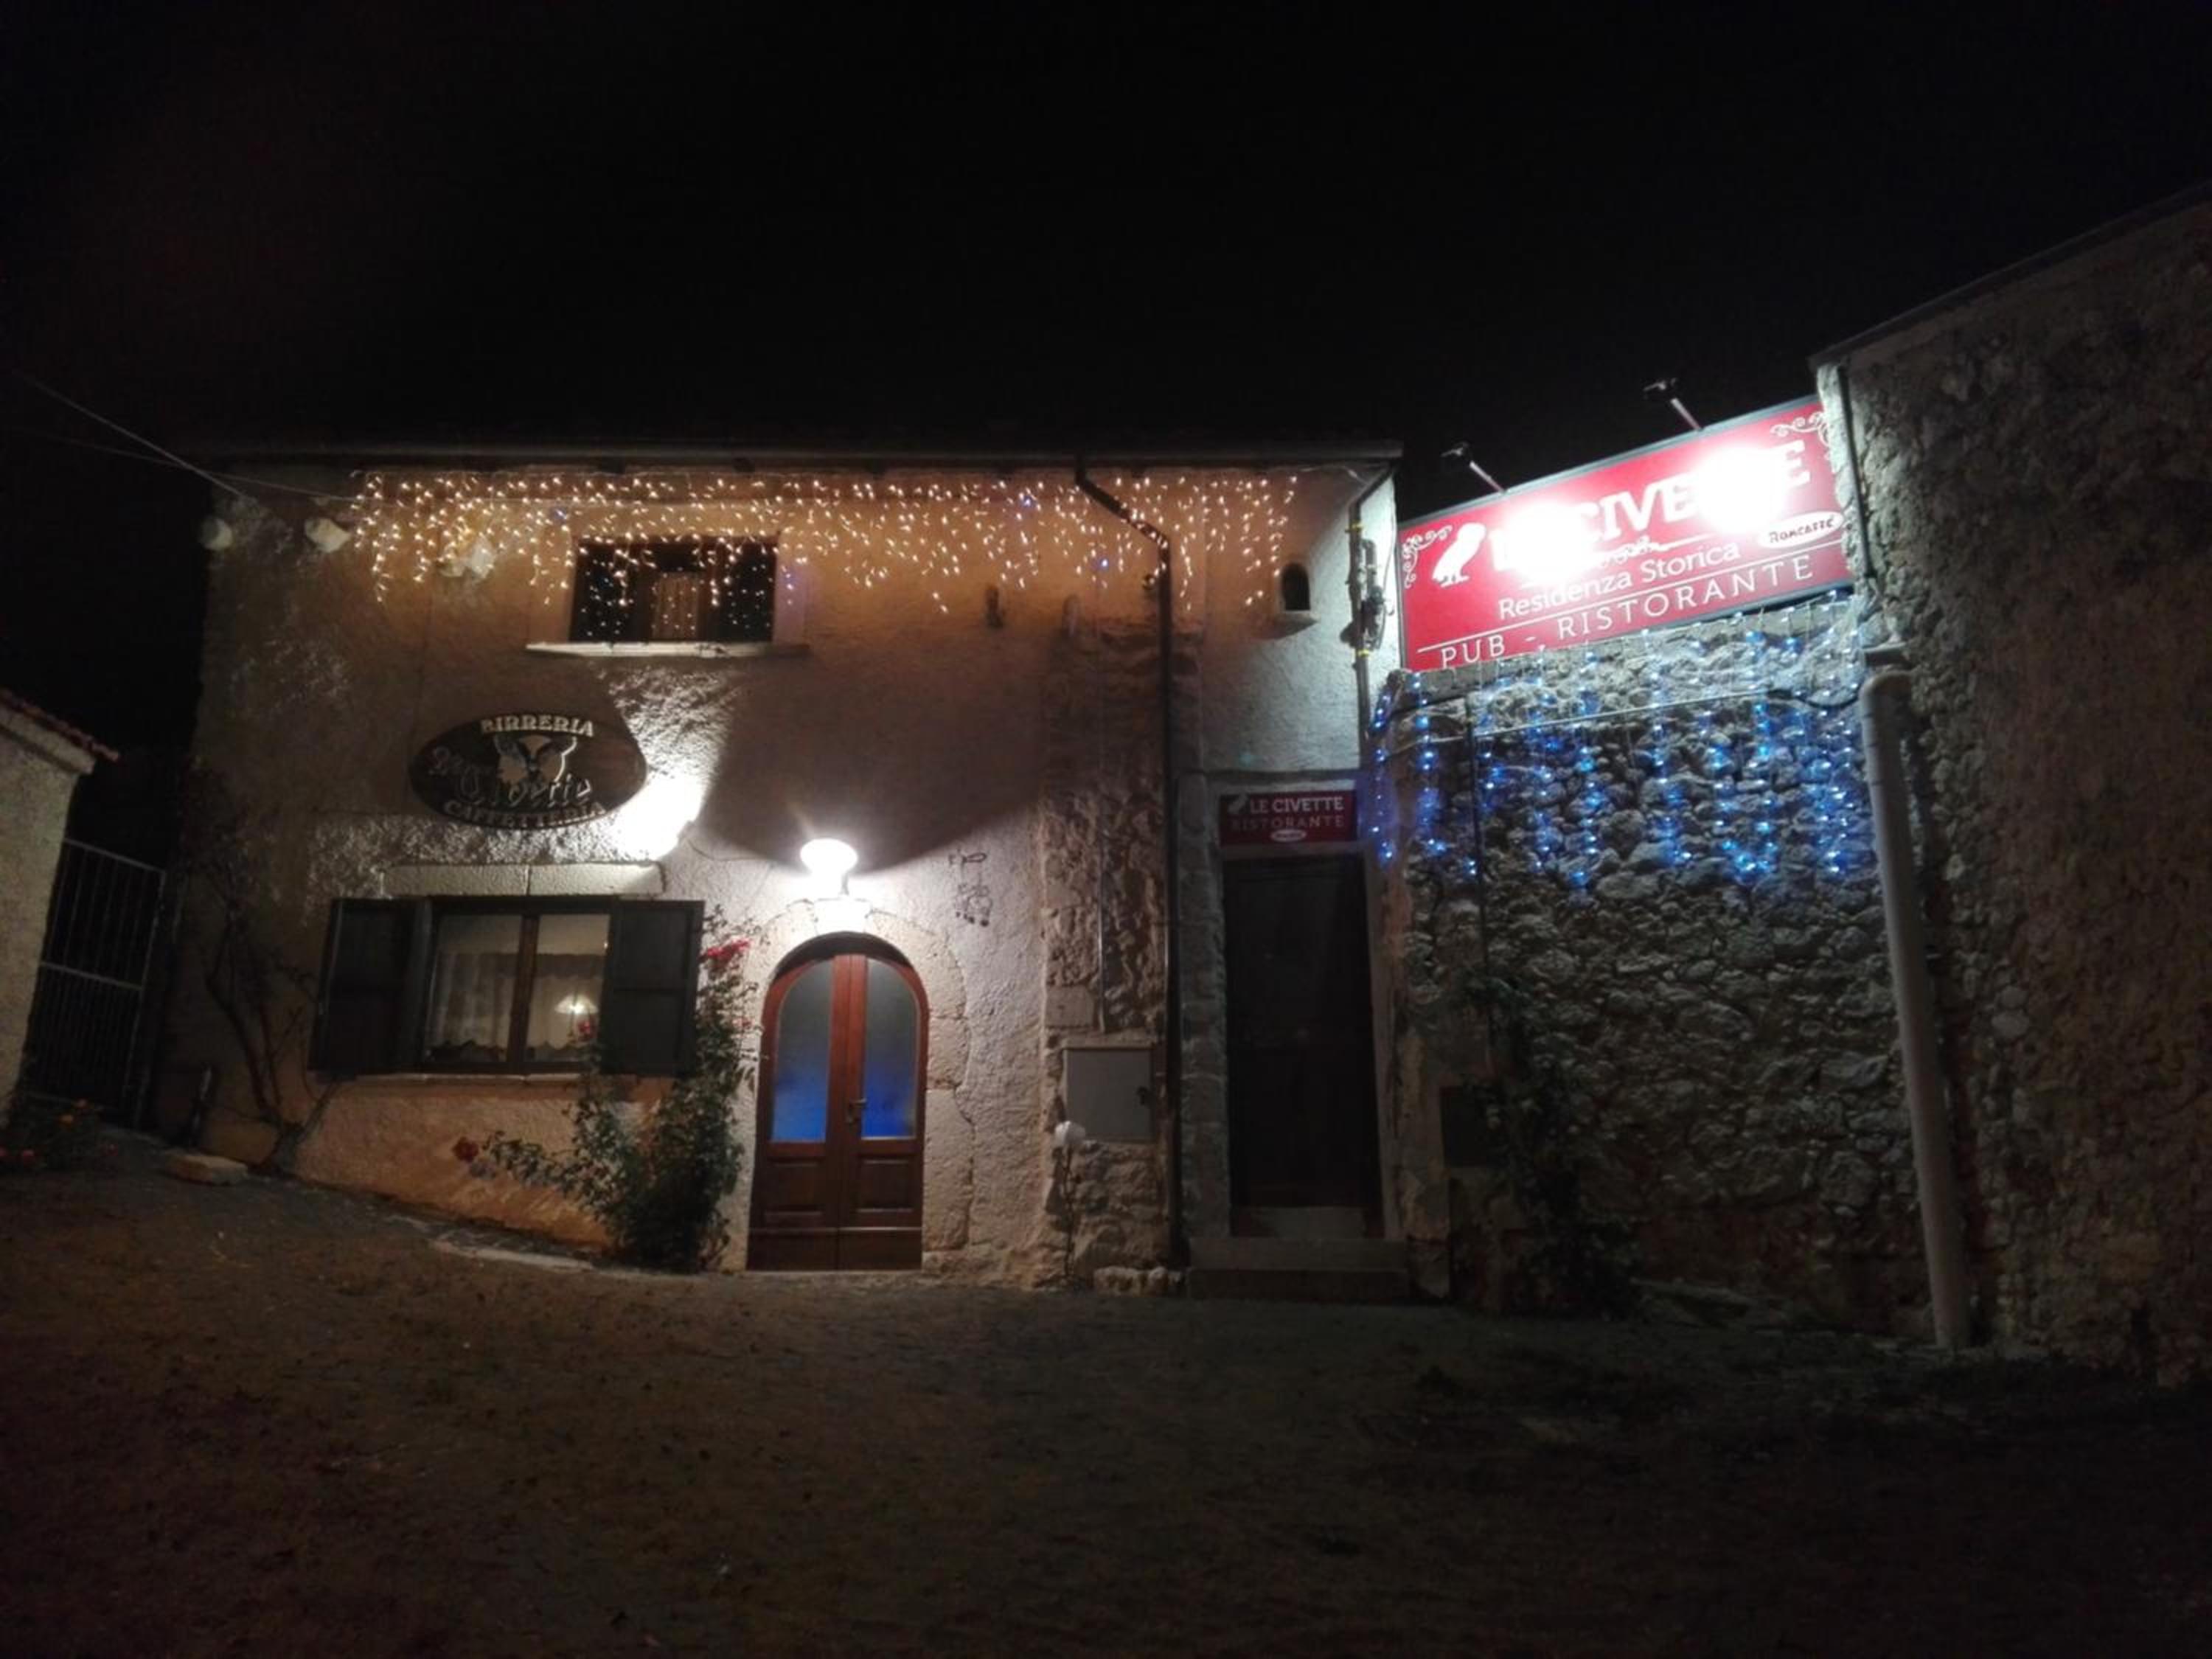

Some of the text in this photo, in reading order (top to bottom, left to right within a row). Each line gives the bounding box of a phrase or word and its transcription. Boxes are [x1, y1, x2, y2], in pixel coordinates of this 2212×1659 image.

[1565, 439, 1811, 547] CIVEE
[1498, 541, 1741, 619] Residenza Storica
[1441, 636, 1506, 668] PUB
[1557, 554, 1813, 640] RISTORANTE
[480, 714, 594, 738] BIRRERIA
[1230, 815, 1345, 831] RISTORANTE
[1251, 796, 1344, 814] LE CIVETTE
